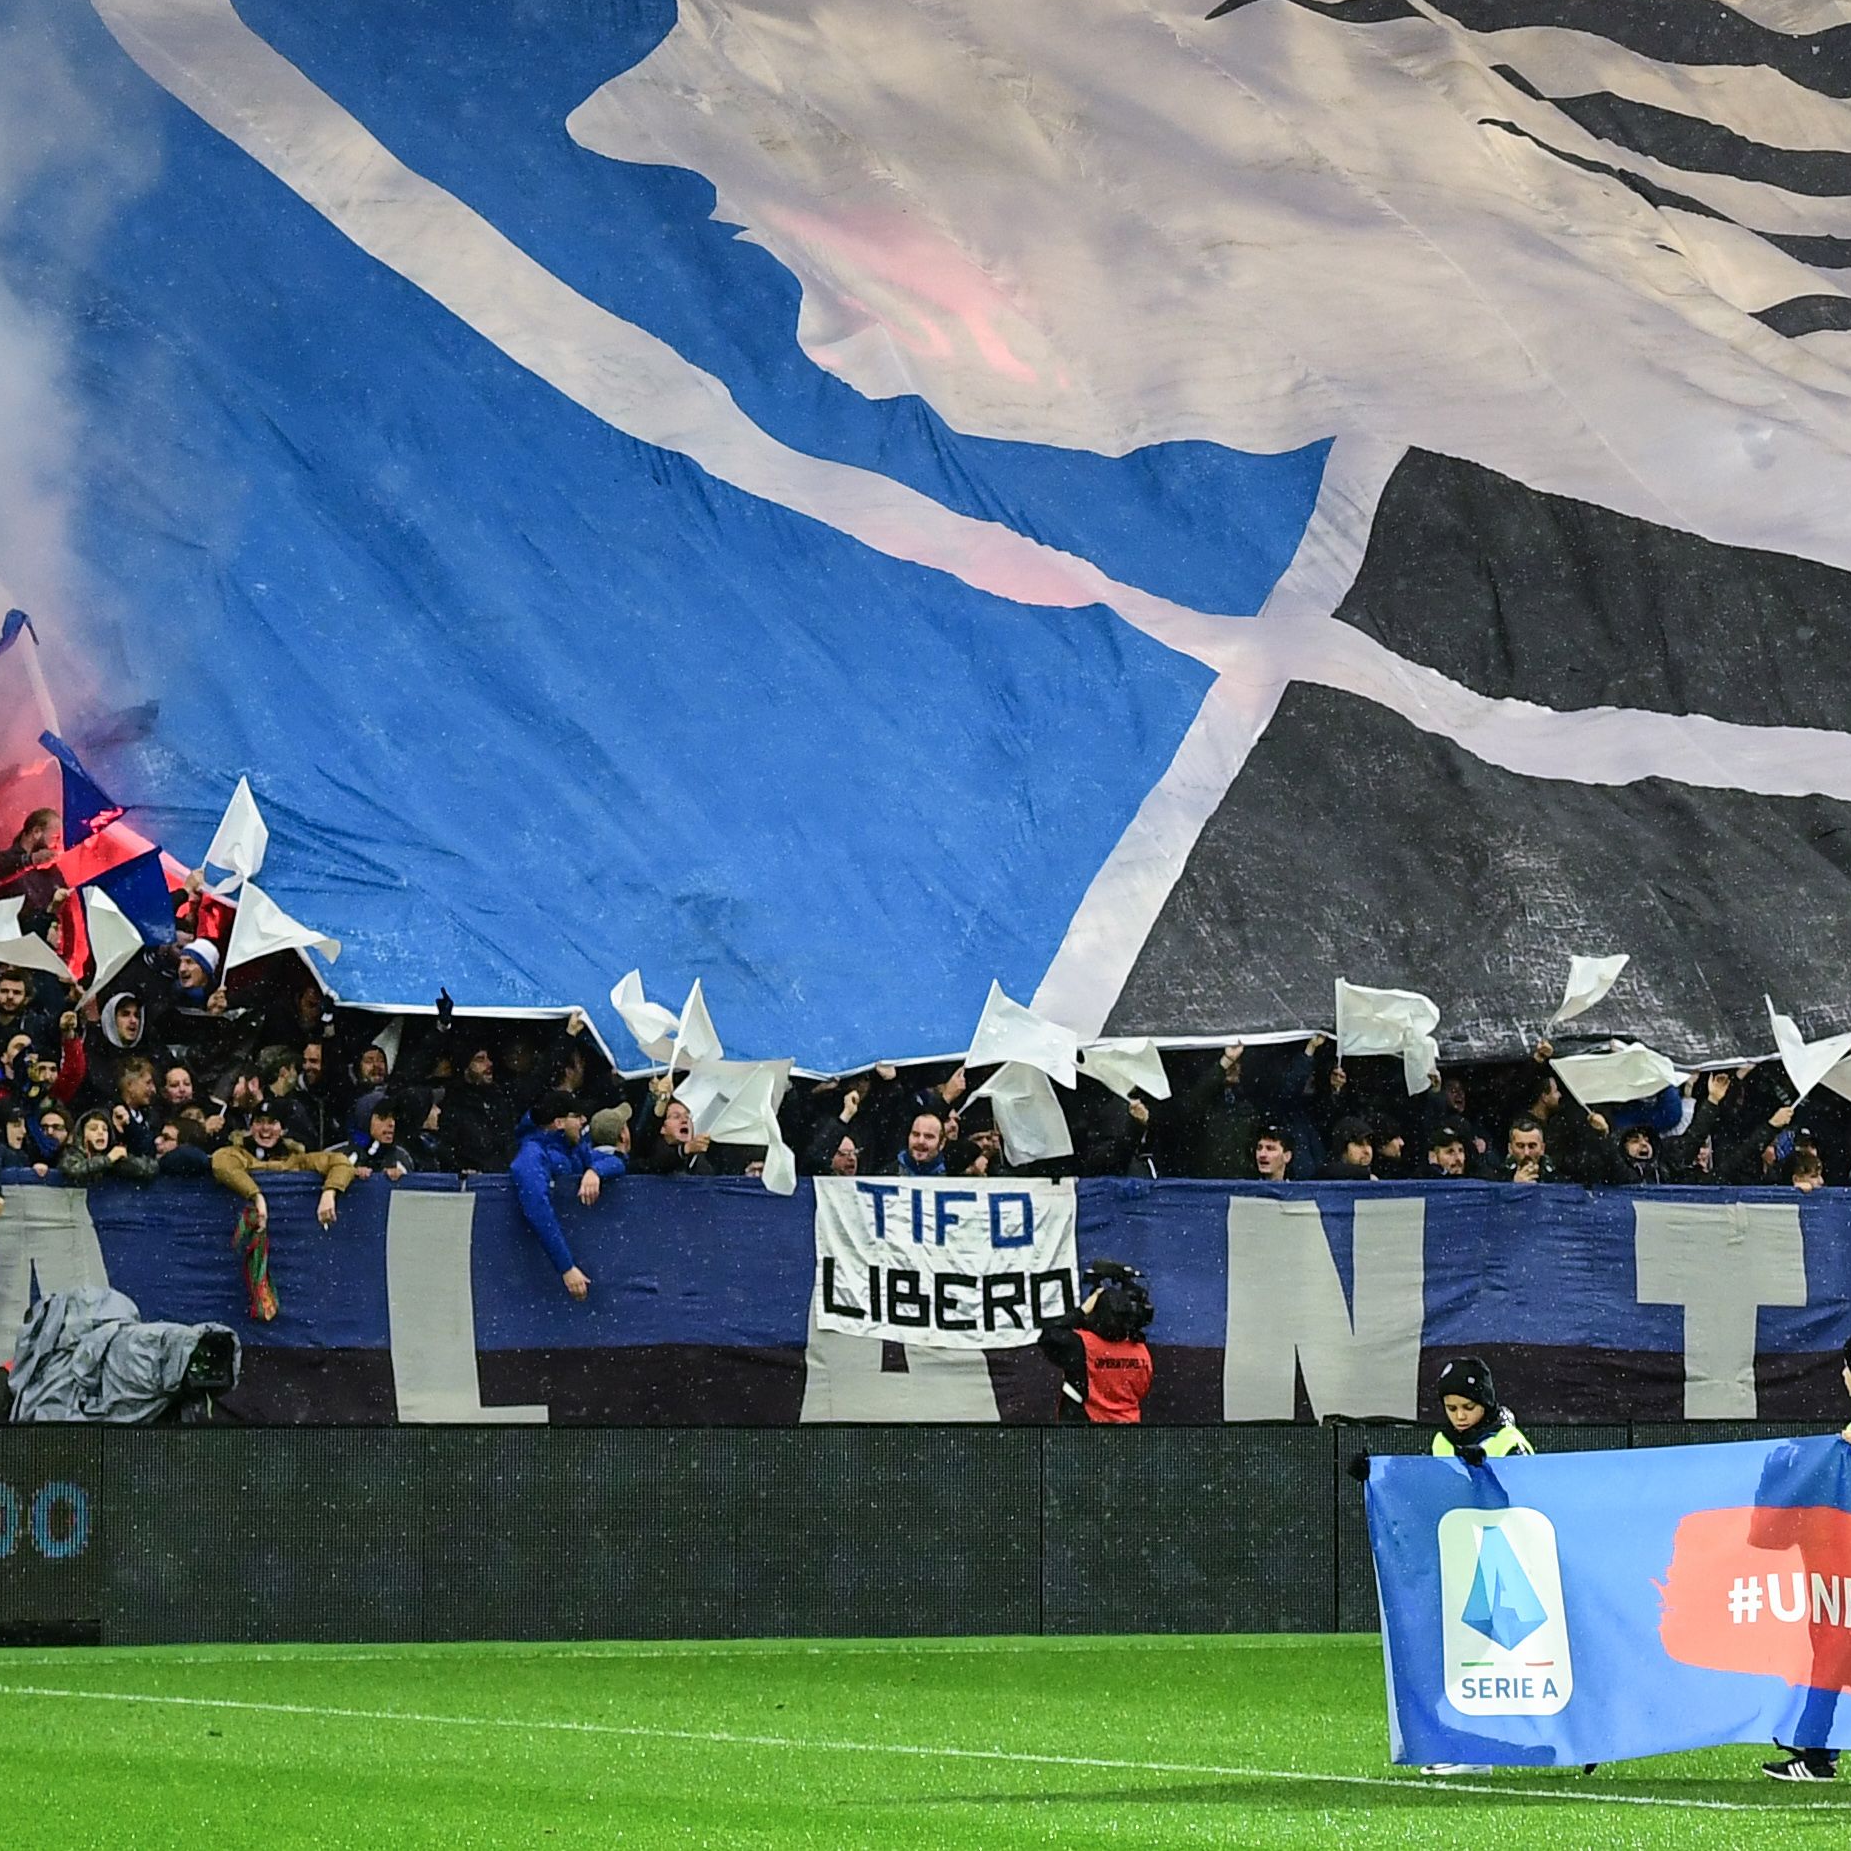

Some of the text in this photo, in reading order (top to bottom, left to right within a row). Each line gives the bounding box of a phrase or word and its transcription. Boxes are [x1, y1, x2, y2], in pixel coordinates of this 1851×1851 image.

[856, 1180, 1035, 1249] TIFO
[823, 1256, 1075, 1332] LIBERO
[1461, 1677, 1559, 1700] SERIE A
